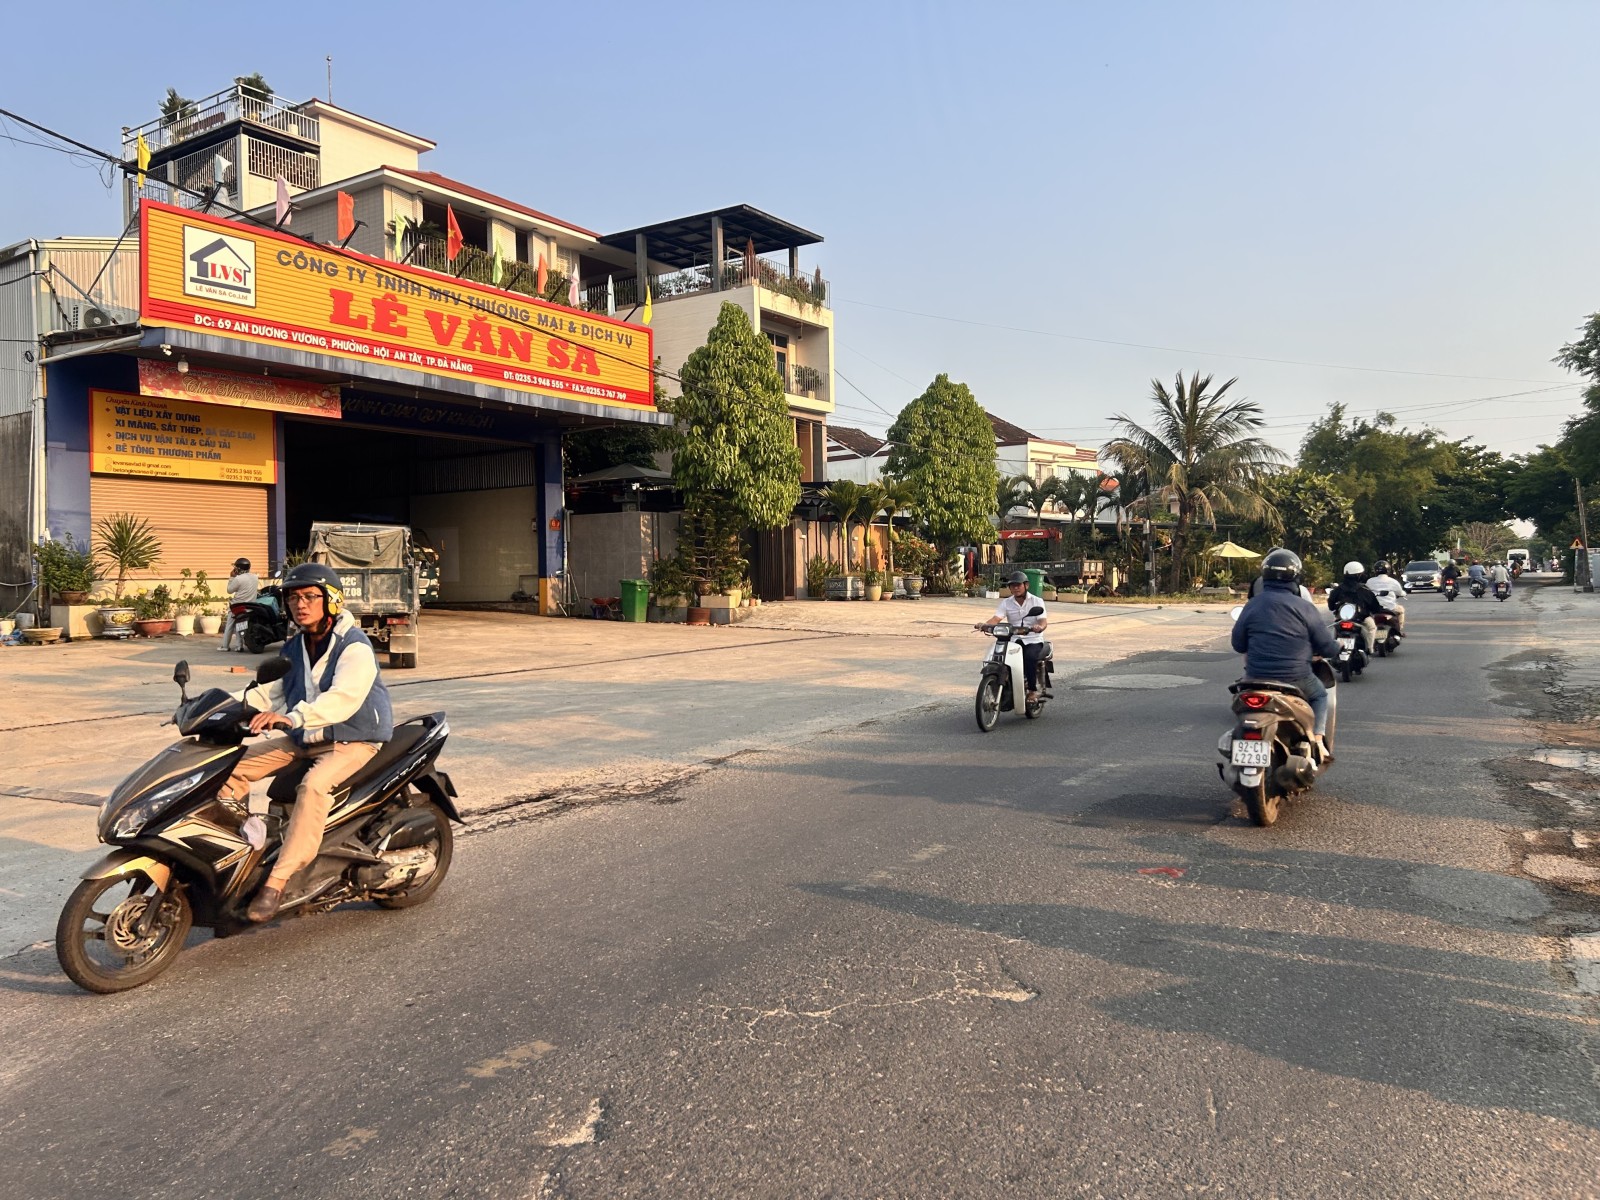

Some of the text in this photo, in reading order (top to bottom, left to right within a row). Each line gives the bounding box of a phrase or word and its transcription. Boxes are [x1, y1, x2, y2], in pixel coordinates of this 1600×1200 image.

[210, 262, 242, 284] LVS
[276, 250, 633, 348] CÔNG TY TNHH MTV THƯƠNG MẠI & DỊCH VỤ
[329, 288, 601, 376] LÊ VĂN SA
[194, 314, 473, 373] ĐC: 69 AN DƯƠNG VƯƠNG, PHƯỜNG HỘI AN TÂY, TP.ĐÀ NẴNG
[182, 376, 212, 396] Chúc
[216, 380, 251, 405] Mừng
[503, 371, 514, 380] ĐT:
[515, 374, 537, 384] 0235.3
[538, 378, 550, 387] 948
[551, 381, 564, 389] 555
[606, 390, 615, 398] 767
[616, 392, 627, 400] 769
[106, 396, 130, 405] Chuyên
[342, 397, 381, 414] KÍNH
[115, 405, 200, 423] VẬT LIỆU XÂY DỰNG
[161, 422, 177, 432] SẮT
[116, 432, 137, 441] DỊCH
[140, 434, 152, 444] VỤ
[155, 434, 172, 444] VẬN
[175, 436, 188, 446] TẢI
[116, 443, 221, 460] BÊ TÔNG THƯƠNG PHẨM
[340, 576, 357, 586] 92C
[1238, 741, 1263, 753] 92-C1
[1234, 753, 1268, 764] 422.99
